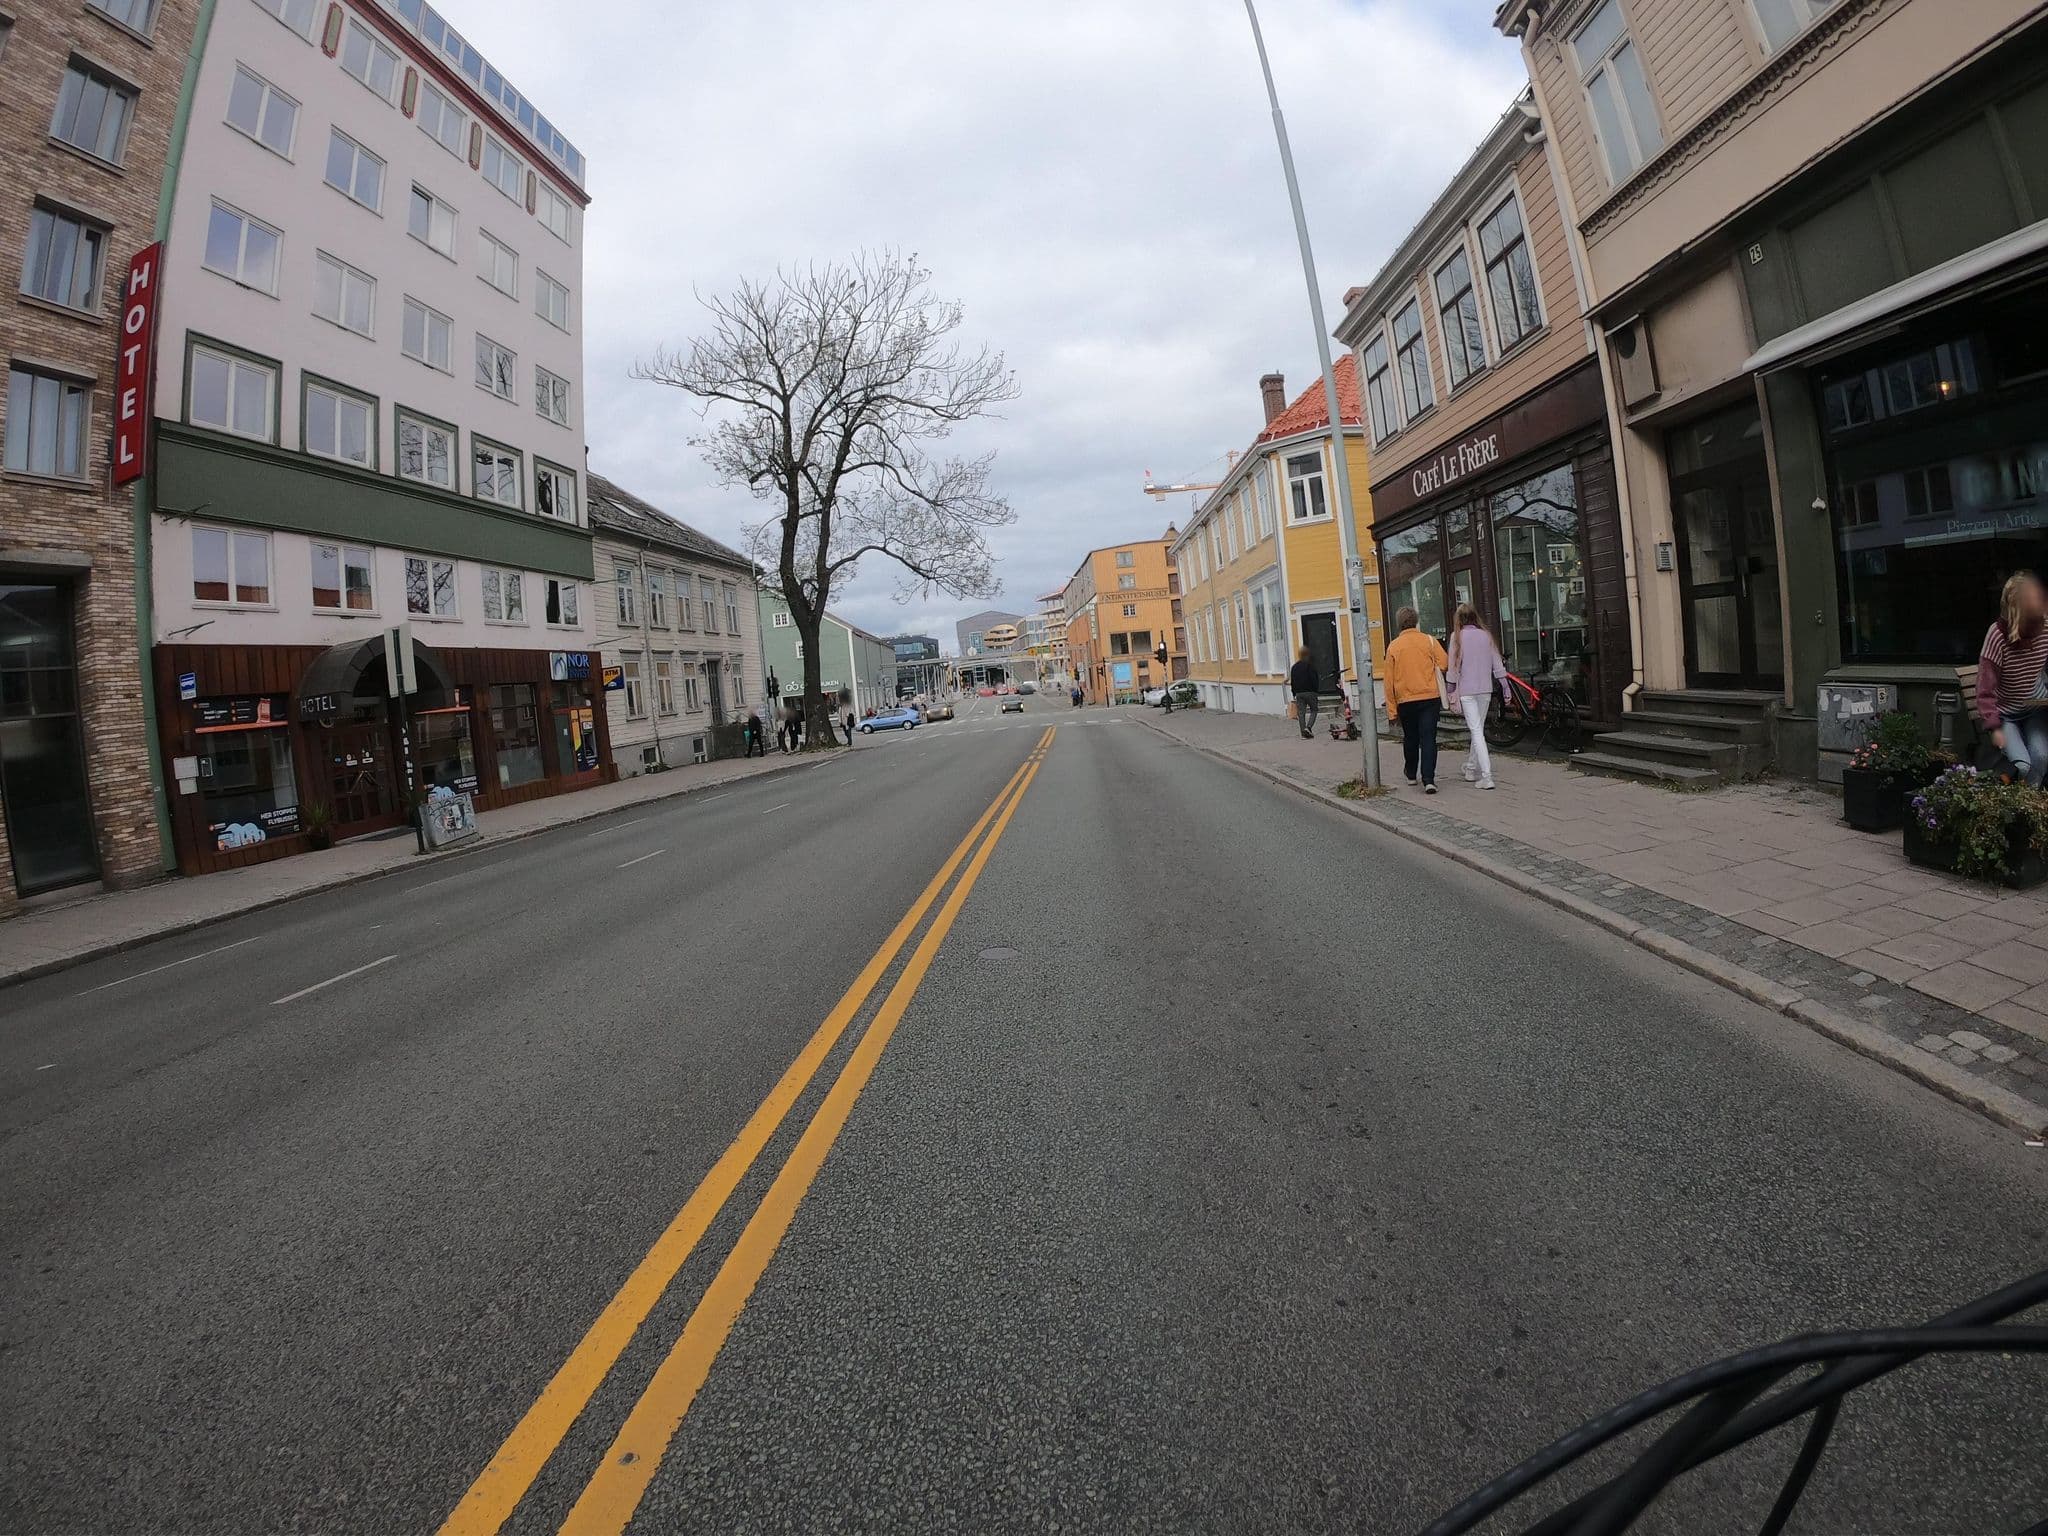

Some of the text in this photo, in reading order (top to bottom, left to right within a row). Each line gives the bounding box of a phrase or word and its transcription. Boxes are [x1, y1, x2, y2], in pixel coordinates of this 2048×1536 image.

[1751, 245, 1761, 262] 25
[120, 261, 150, 465] HOTEL
[568, 653, 590, 668] NOR
[604, 669, 619, 677] ATM
[301, 696, 336, 712] HOTEL
